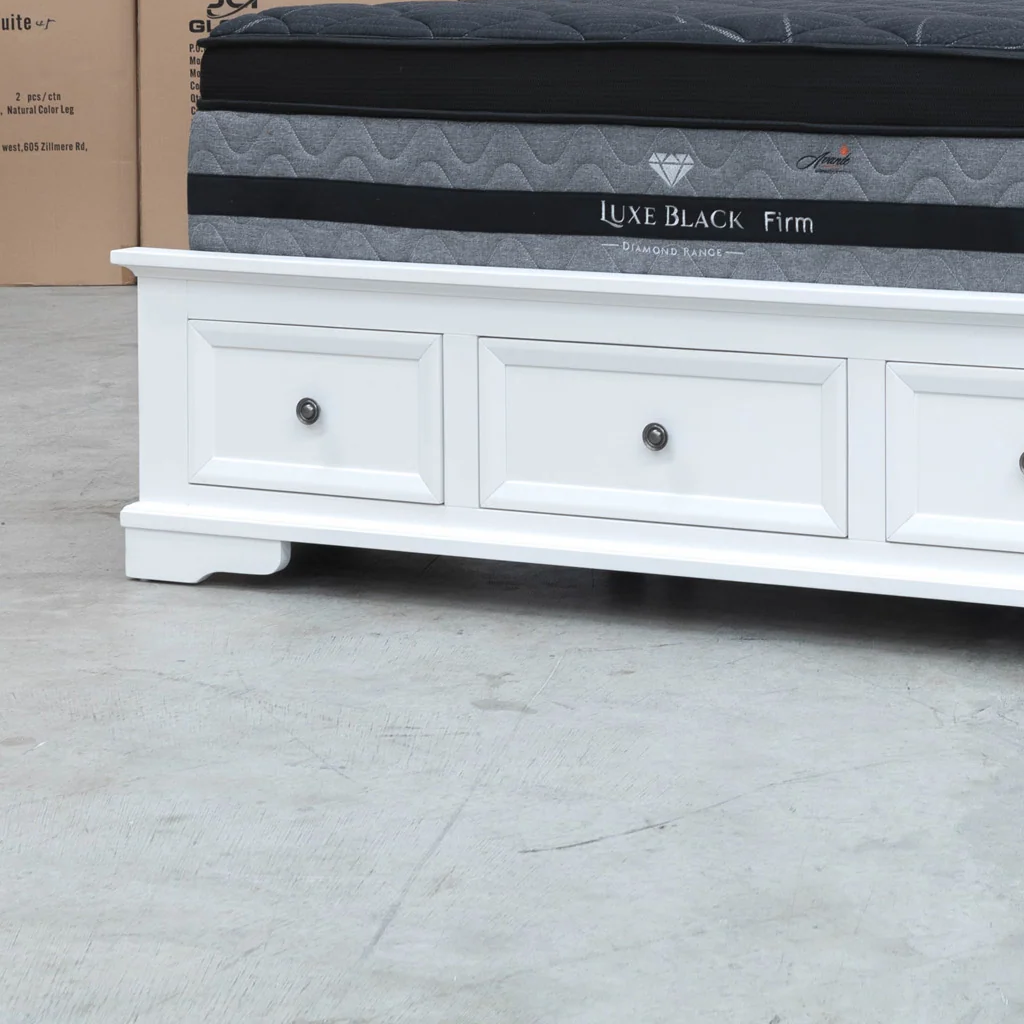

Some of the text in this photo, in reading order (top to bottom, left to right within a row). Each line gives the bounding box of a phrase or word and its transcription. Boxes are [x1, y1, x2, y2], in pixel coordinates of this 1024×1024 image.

[0, 14, 32, 31] uite
[7, 105, 74, 114] Natural Color Leg
[41, 142, 73, 151] Zillmere
[764, 211, 814, 233] Firm
